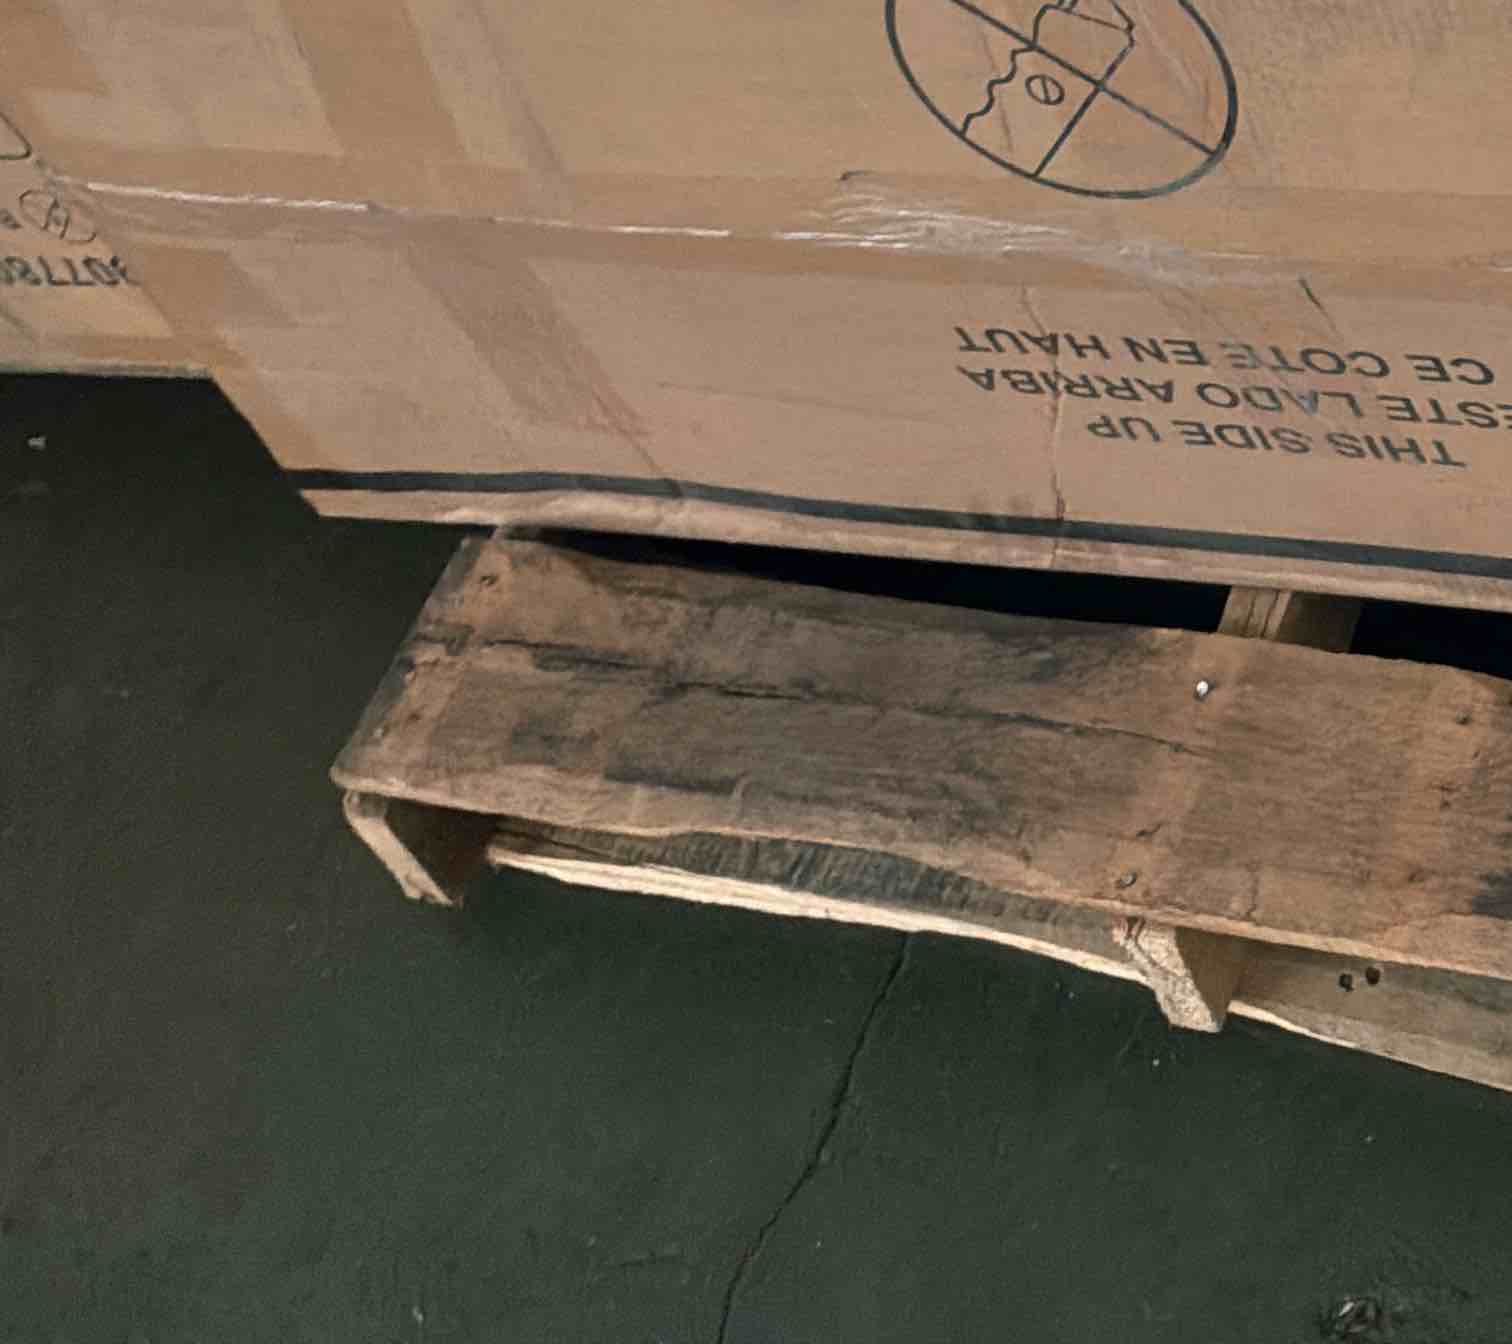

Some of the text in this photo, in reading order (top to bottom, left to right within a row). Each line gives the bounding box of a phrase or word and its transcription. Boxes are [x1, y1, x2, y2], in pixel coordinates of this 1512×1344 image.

[955, 326, 1495, 387] CE COTE EN HAUT
[955, 364, 1176, 405] ARRIBA
[1193, 380, 1364, 422] LADO
[1084, 413, 1468, 468] THIS SIDE UP
